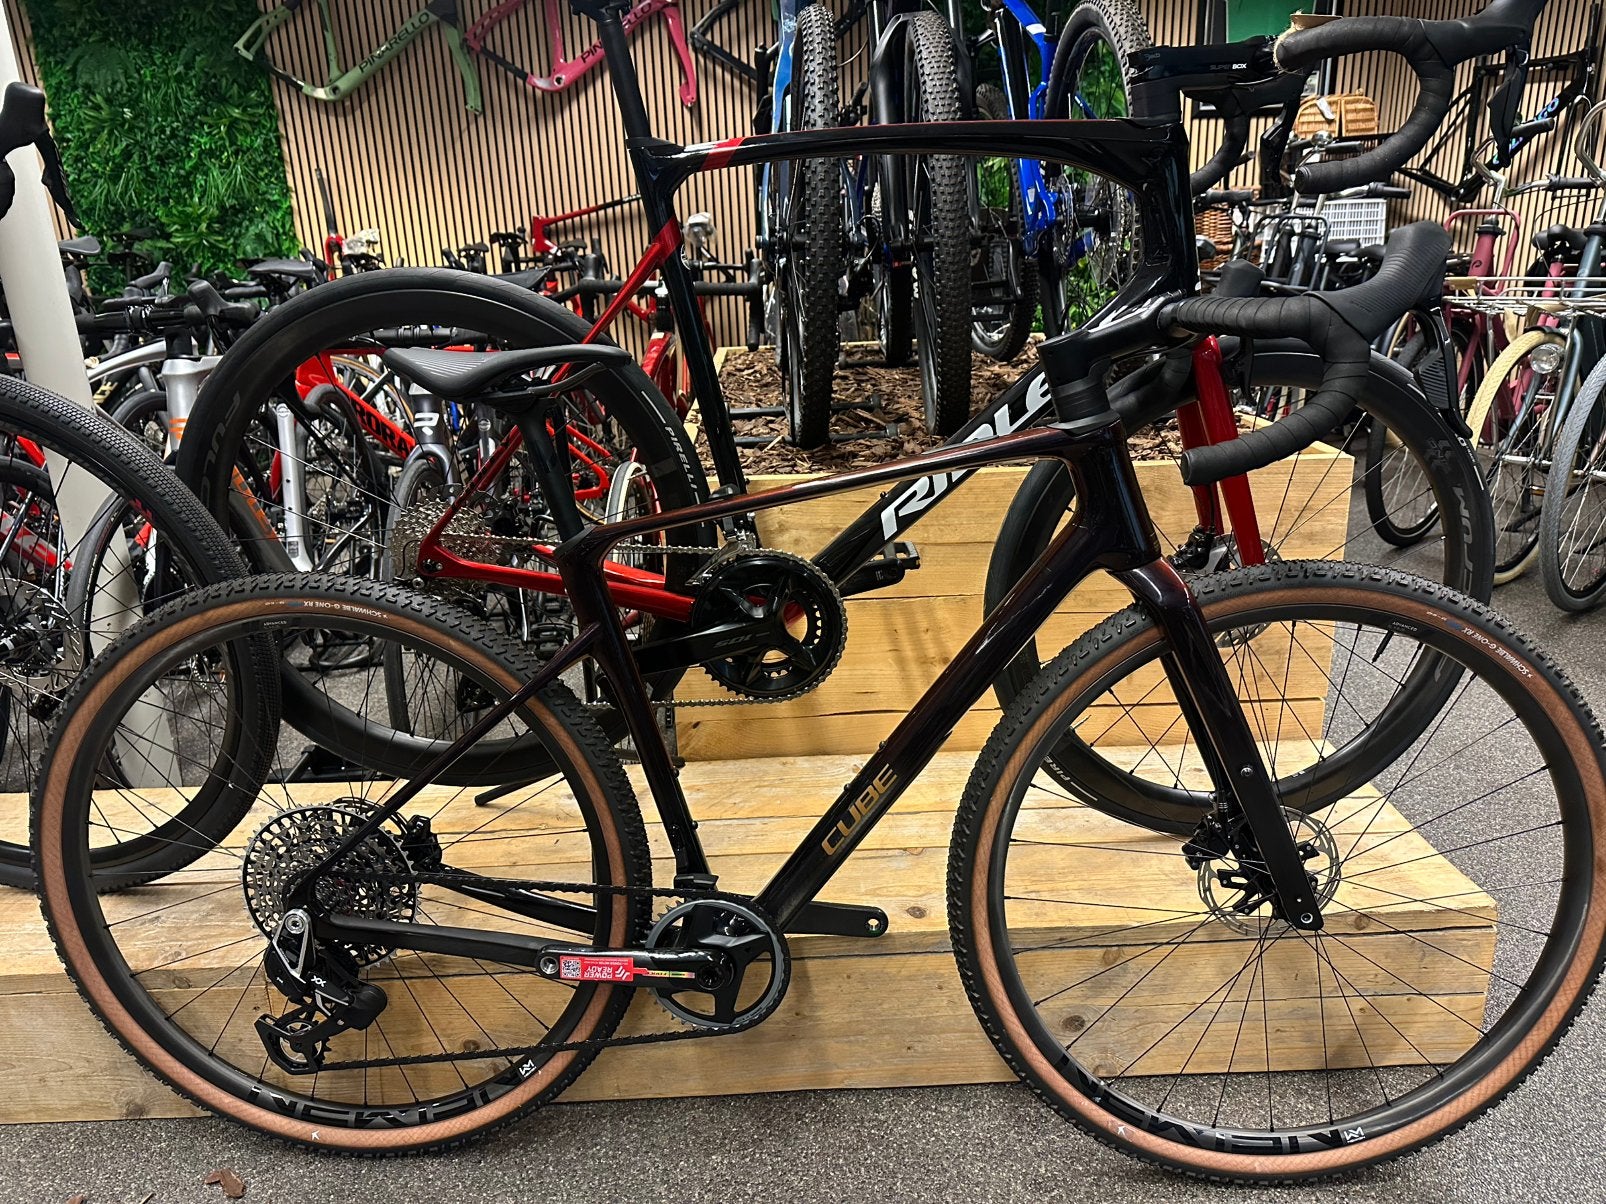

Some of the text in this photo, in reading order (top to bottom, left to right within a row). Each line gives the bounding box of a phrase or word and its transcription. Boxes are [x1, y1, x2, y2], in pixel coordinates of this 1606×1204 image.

[358, 12, 430, 73] PINARELLO
[580, 2, 652, 64] PINLLO
[664, 426, 698, 489] PIRELLI
[315, 601, 340, 609] G-ONE
[342, 604, 382, 618] SCHWALBE
[1463, 627, 1529, 675] SCHWALBE G-ONE RX
[821, 762, 898, 856] CUBE
[586, 965, 613, 973] READY
